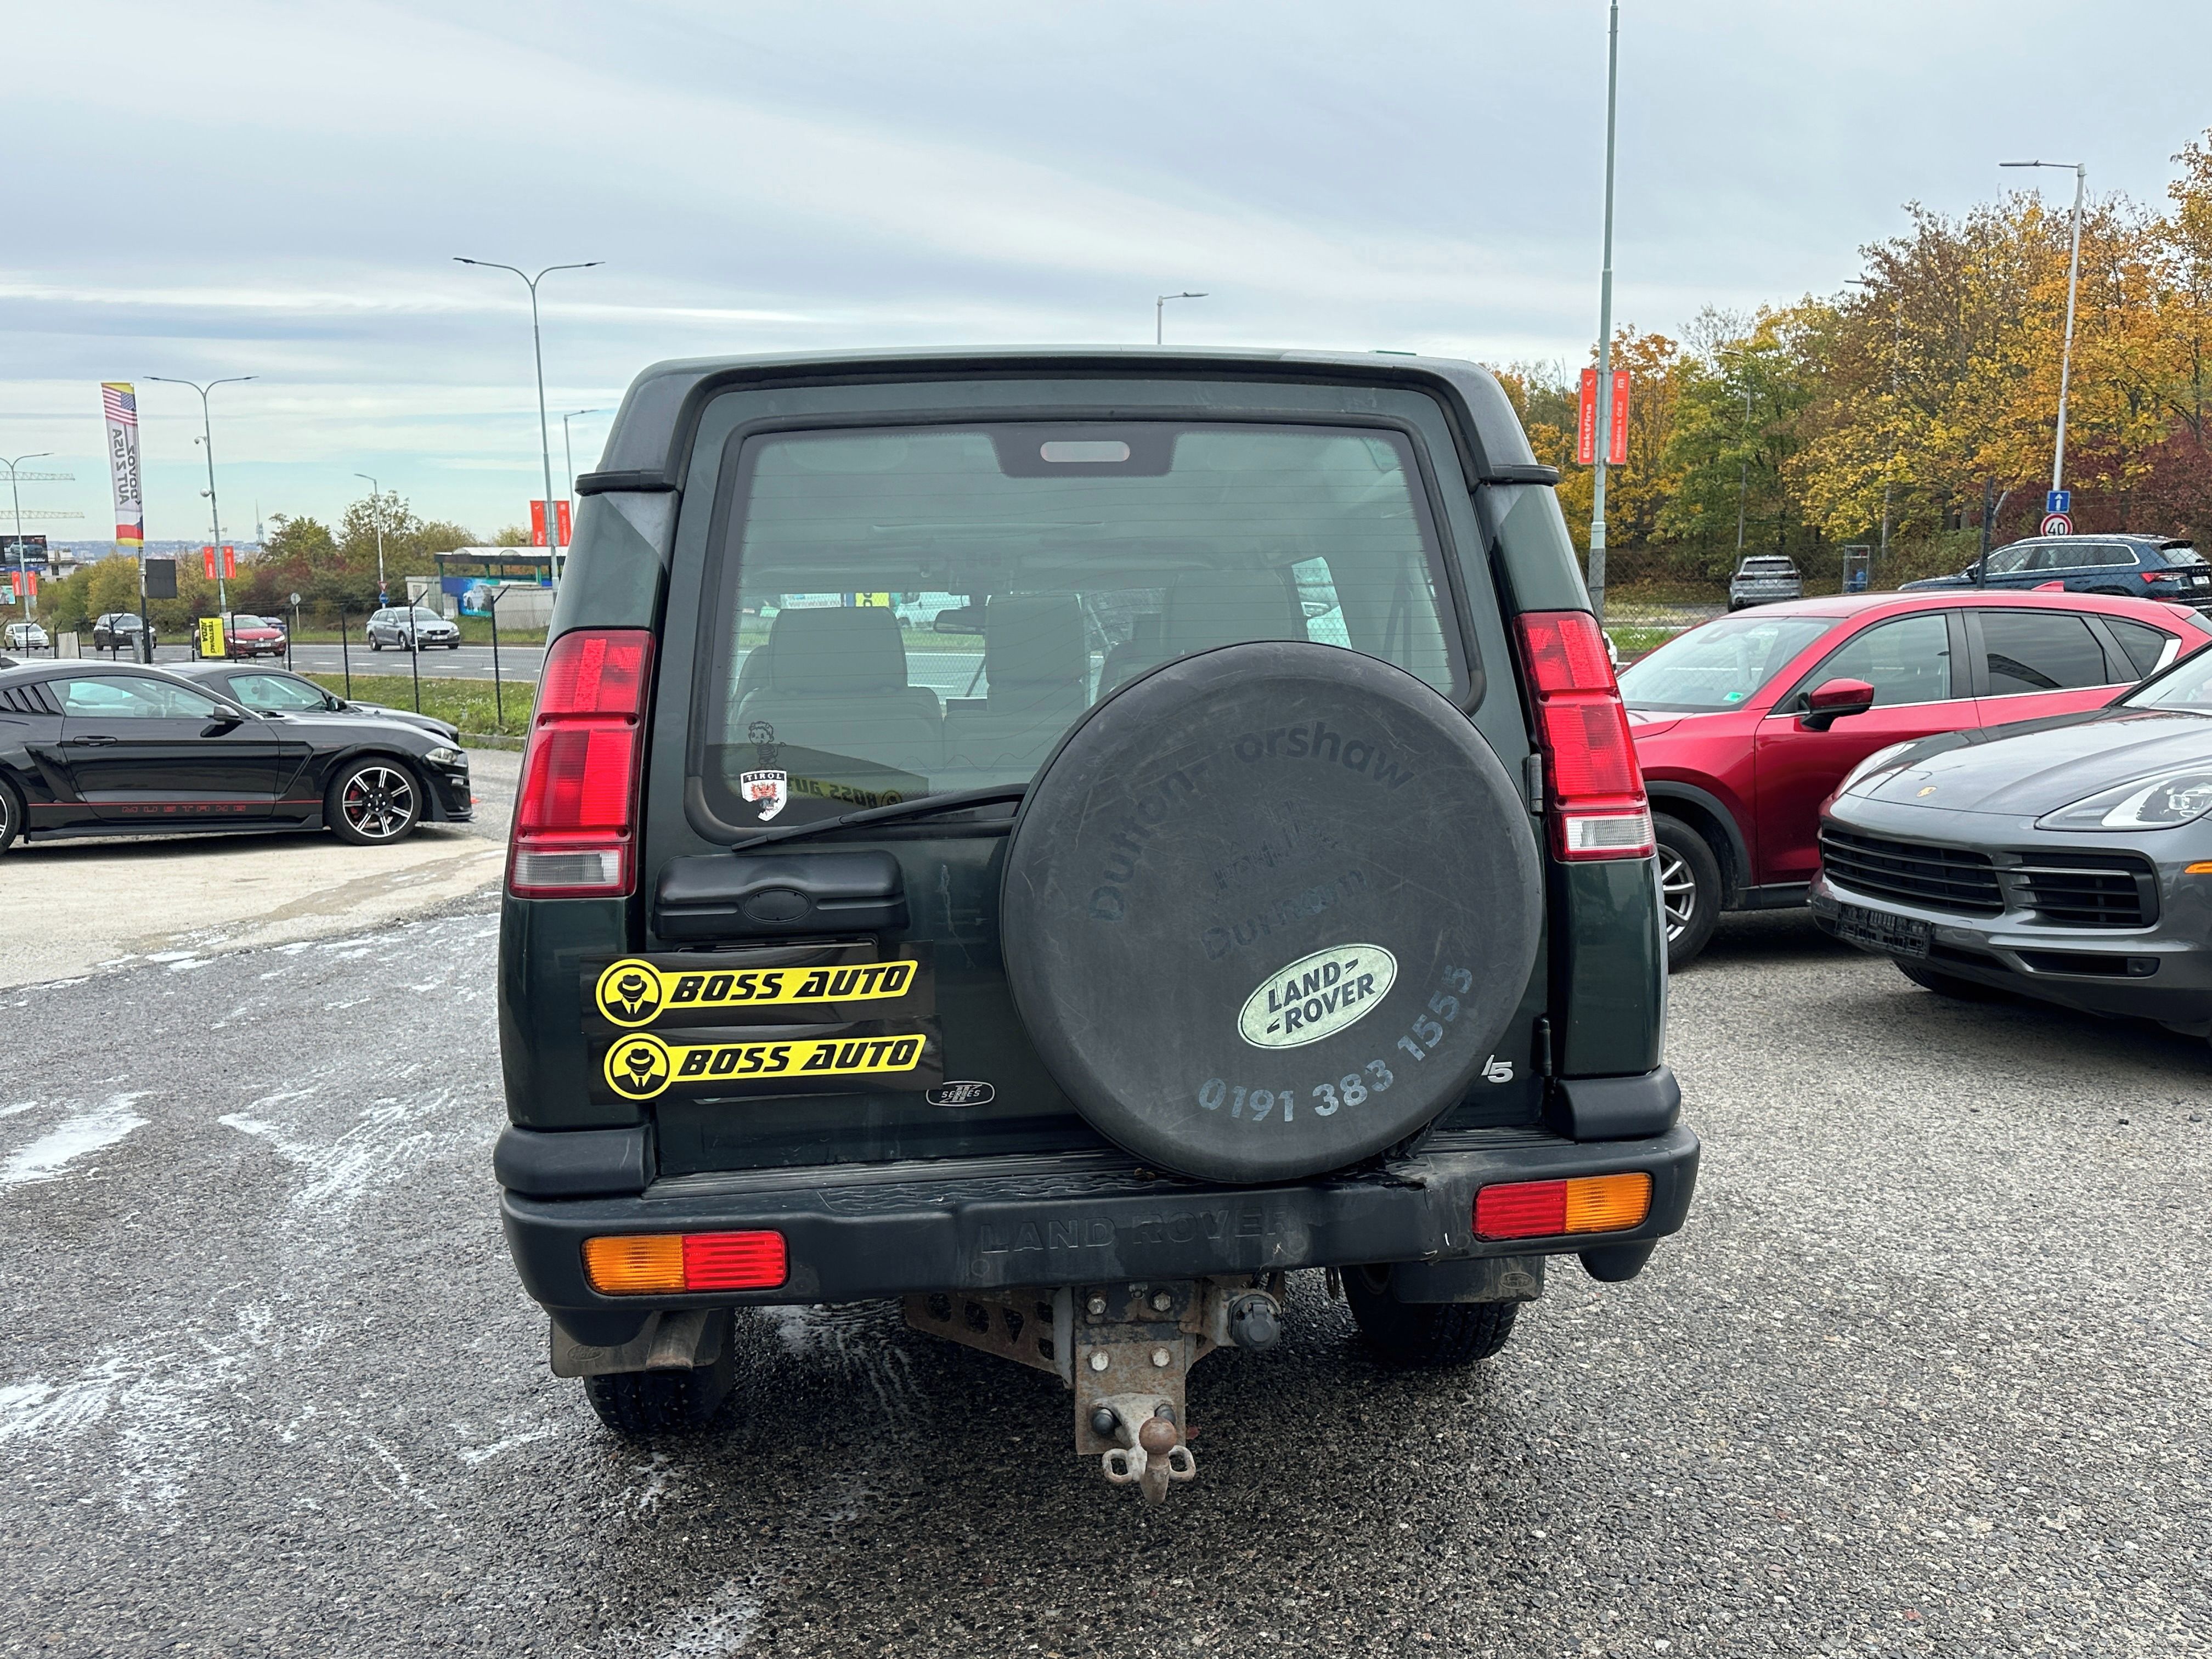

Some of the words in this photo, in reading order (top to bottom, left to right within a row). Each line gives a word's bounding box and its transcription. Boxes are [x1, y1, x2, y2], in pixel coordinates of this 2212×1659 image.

[2048, 522, 2066, 535] 40
[746, 772, 782, 781] TIROL
[669, 973, 783, 1003] BOSS
[793, 965, 911, 998] AUTO
[677, 1046, 791, 1076] BOSS
[800, 1039, 919, 1071] AUTO
[1199, 1078, 1294, 1123] 0191
[1312, 1059, 1394, 1117] 383
[1397, 965, 1473, 1062] 1555
[941, 1089, 981, 1098] SERIES
[980, 1217, 1116, 1254] LAND
[1132, 1205, 1296, 1245] ROVER
